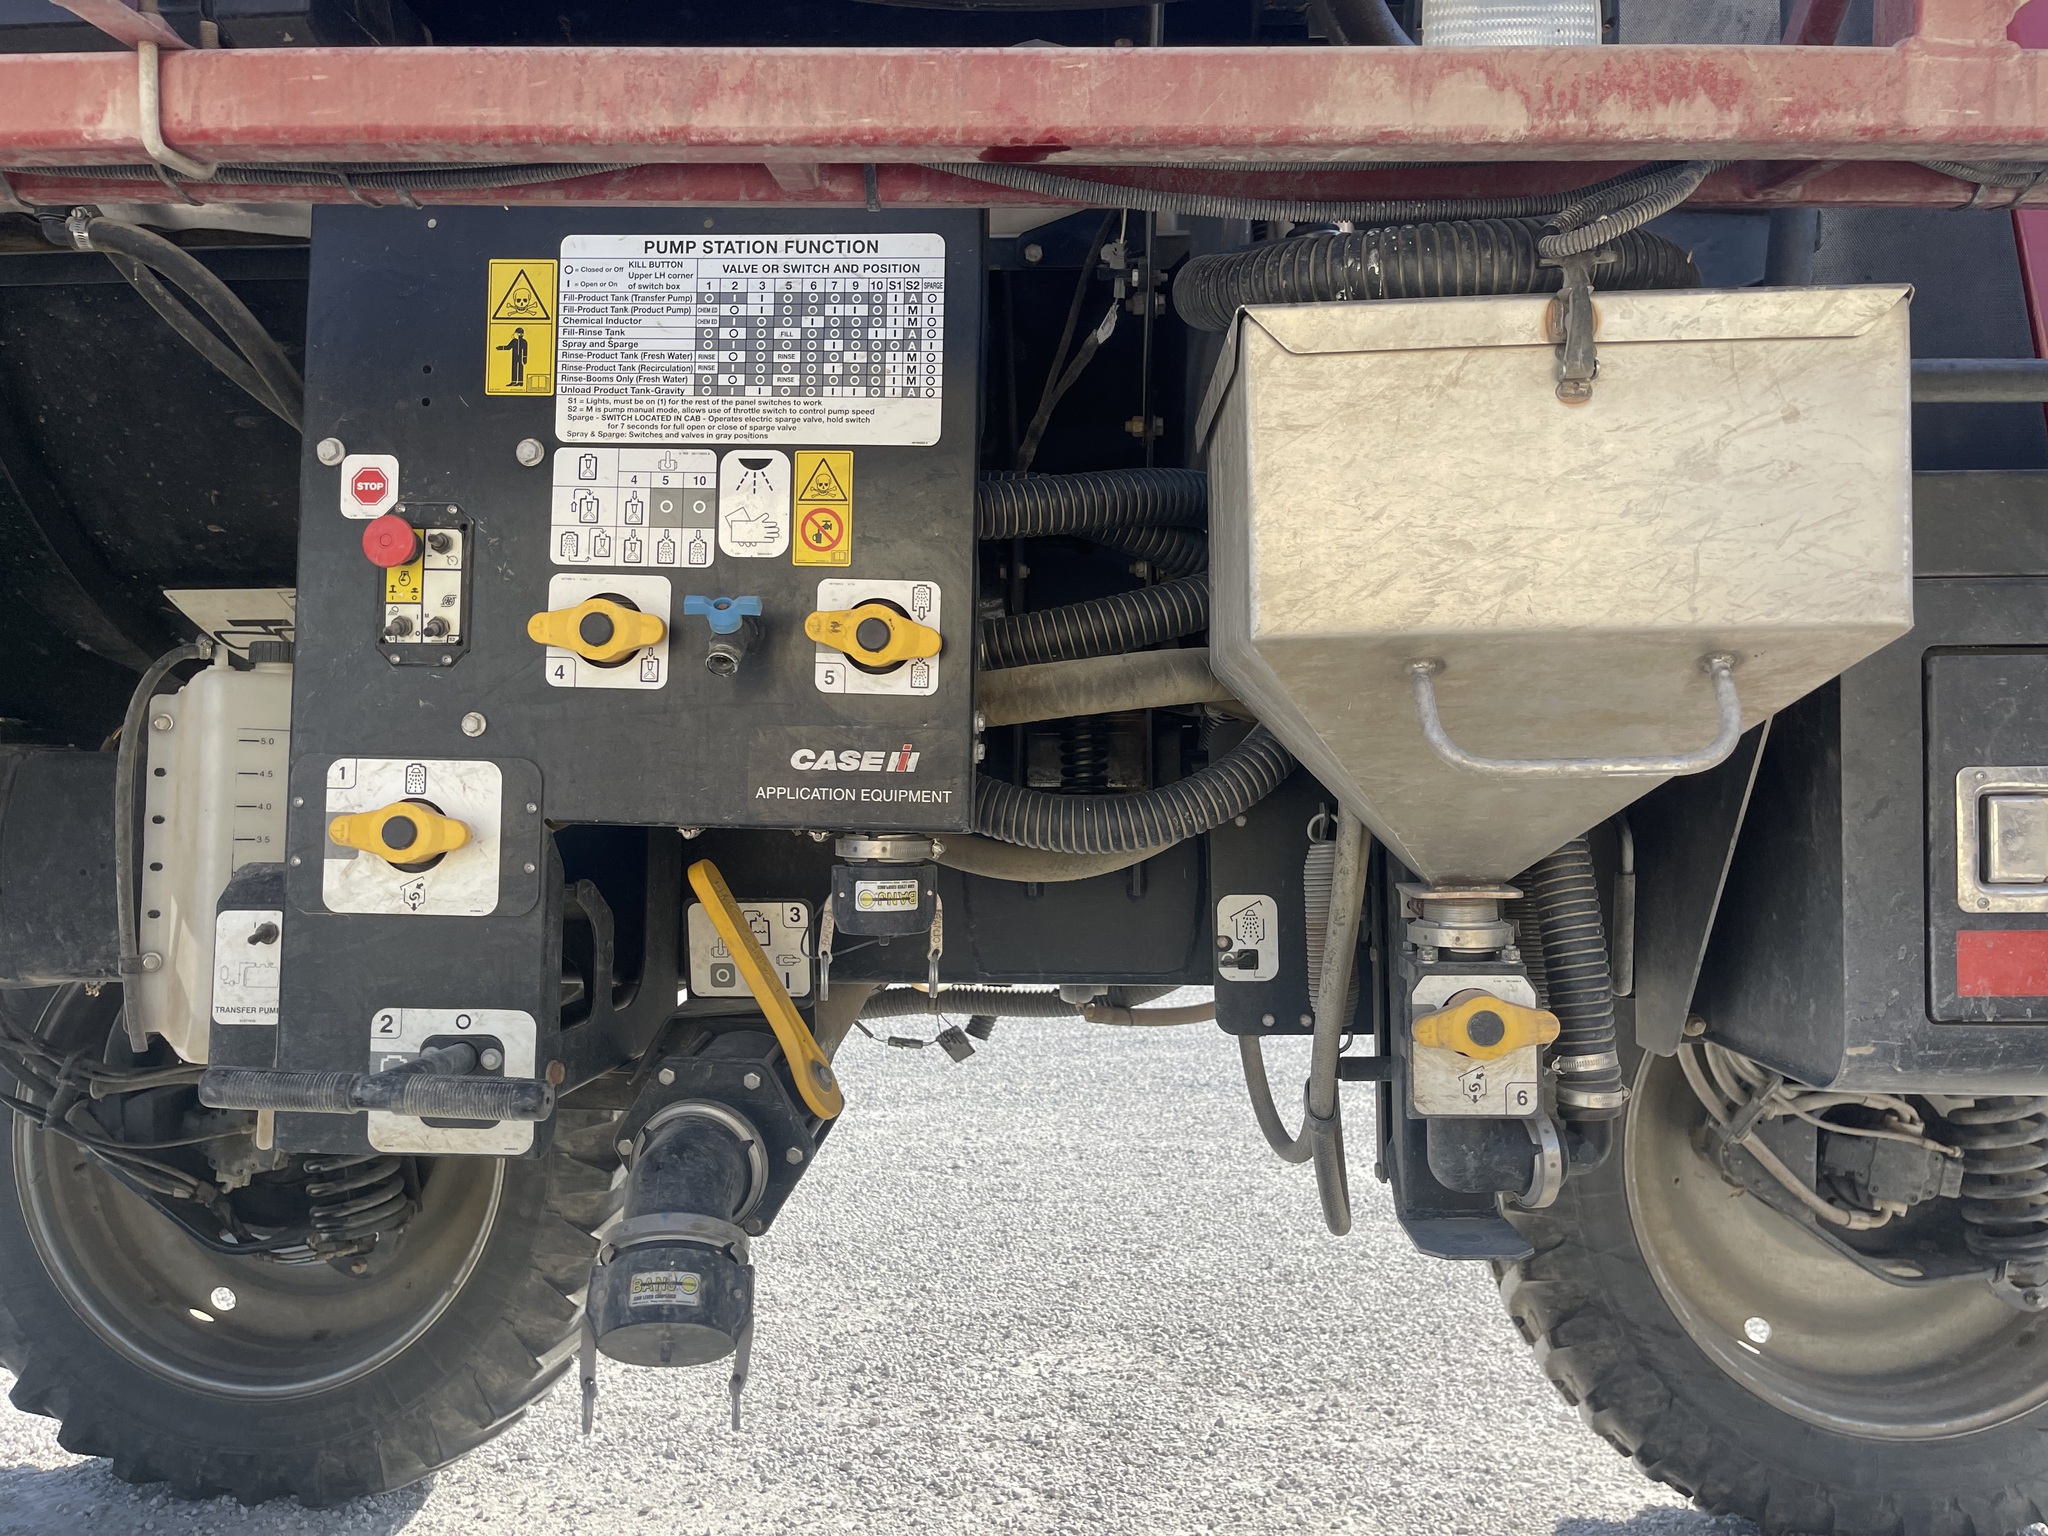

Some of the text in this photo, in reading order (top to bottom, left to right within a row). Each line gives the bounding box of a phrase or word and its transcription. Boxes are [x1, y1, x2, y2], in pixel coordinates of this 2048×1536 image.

[644, 240, 878, 254] PUMP STATION FUNCTION
[722, 264, 920, 273] VALVE OR SWITCH AND POSITION
[628, 272, 652, 280] Upper
[706, 282, 711, 290] 1
[732, 282, 738, 290] 2
[759, 282, 766, 290] 3
[786, 282, 792, 290] 5
[810, 282, 817, 290] 6
[832, 282, 837, 290] 7
[852, 282, 859, 290] 9
[871, 282, 883, 290] 10
[889, 282, 901, 290] S1
[906, 282, 920, 290] S2
[631, 294, 665, 302] (Transfer
[668, 294, 693, 303] Pump)
[630, 306, 664, 315] (Product
[666, 306, 692, 315] Pump)
[562, 340, 587, 348] Spray
[608, 340, 638, 349] Sparge
[640, 352, 666, 360] (Fresh
[667, 352, 693, 360] Water)
[638, 364, 693, 373] (Recirculation)
[616, 375, 634, 384] Only
[636, 375, 661, 384] (Fresh
[662, 376, 688, 384] Water)
[631, 387, 685, 396] Tank-Gravity
[586, 398, 611, 406] Lights,
[657, 398, 666, 406] (1)
[735, 399, 756, 407] panel
[631, 475, 706, 485] 4 5 10
[357, 482, 384, 490] STOP
[554, 665, 565, 679] 4
[824, 670, 834, 685] 5
[790, 749, 886, 772] CASE
[339, 766, 345, 780] 1
[756, 787, 952, 803] APPLICATION EQUIPMENT
[790, 907, 801, 922] 3
[380, 1015, 393, 1033] 2
[1517, 1090, 1528, 1106] 6
